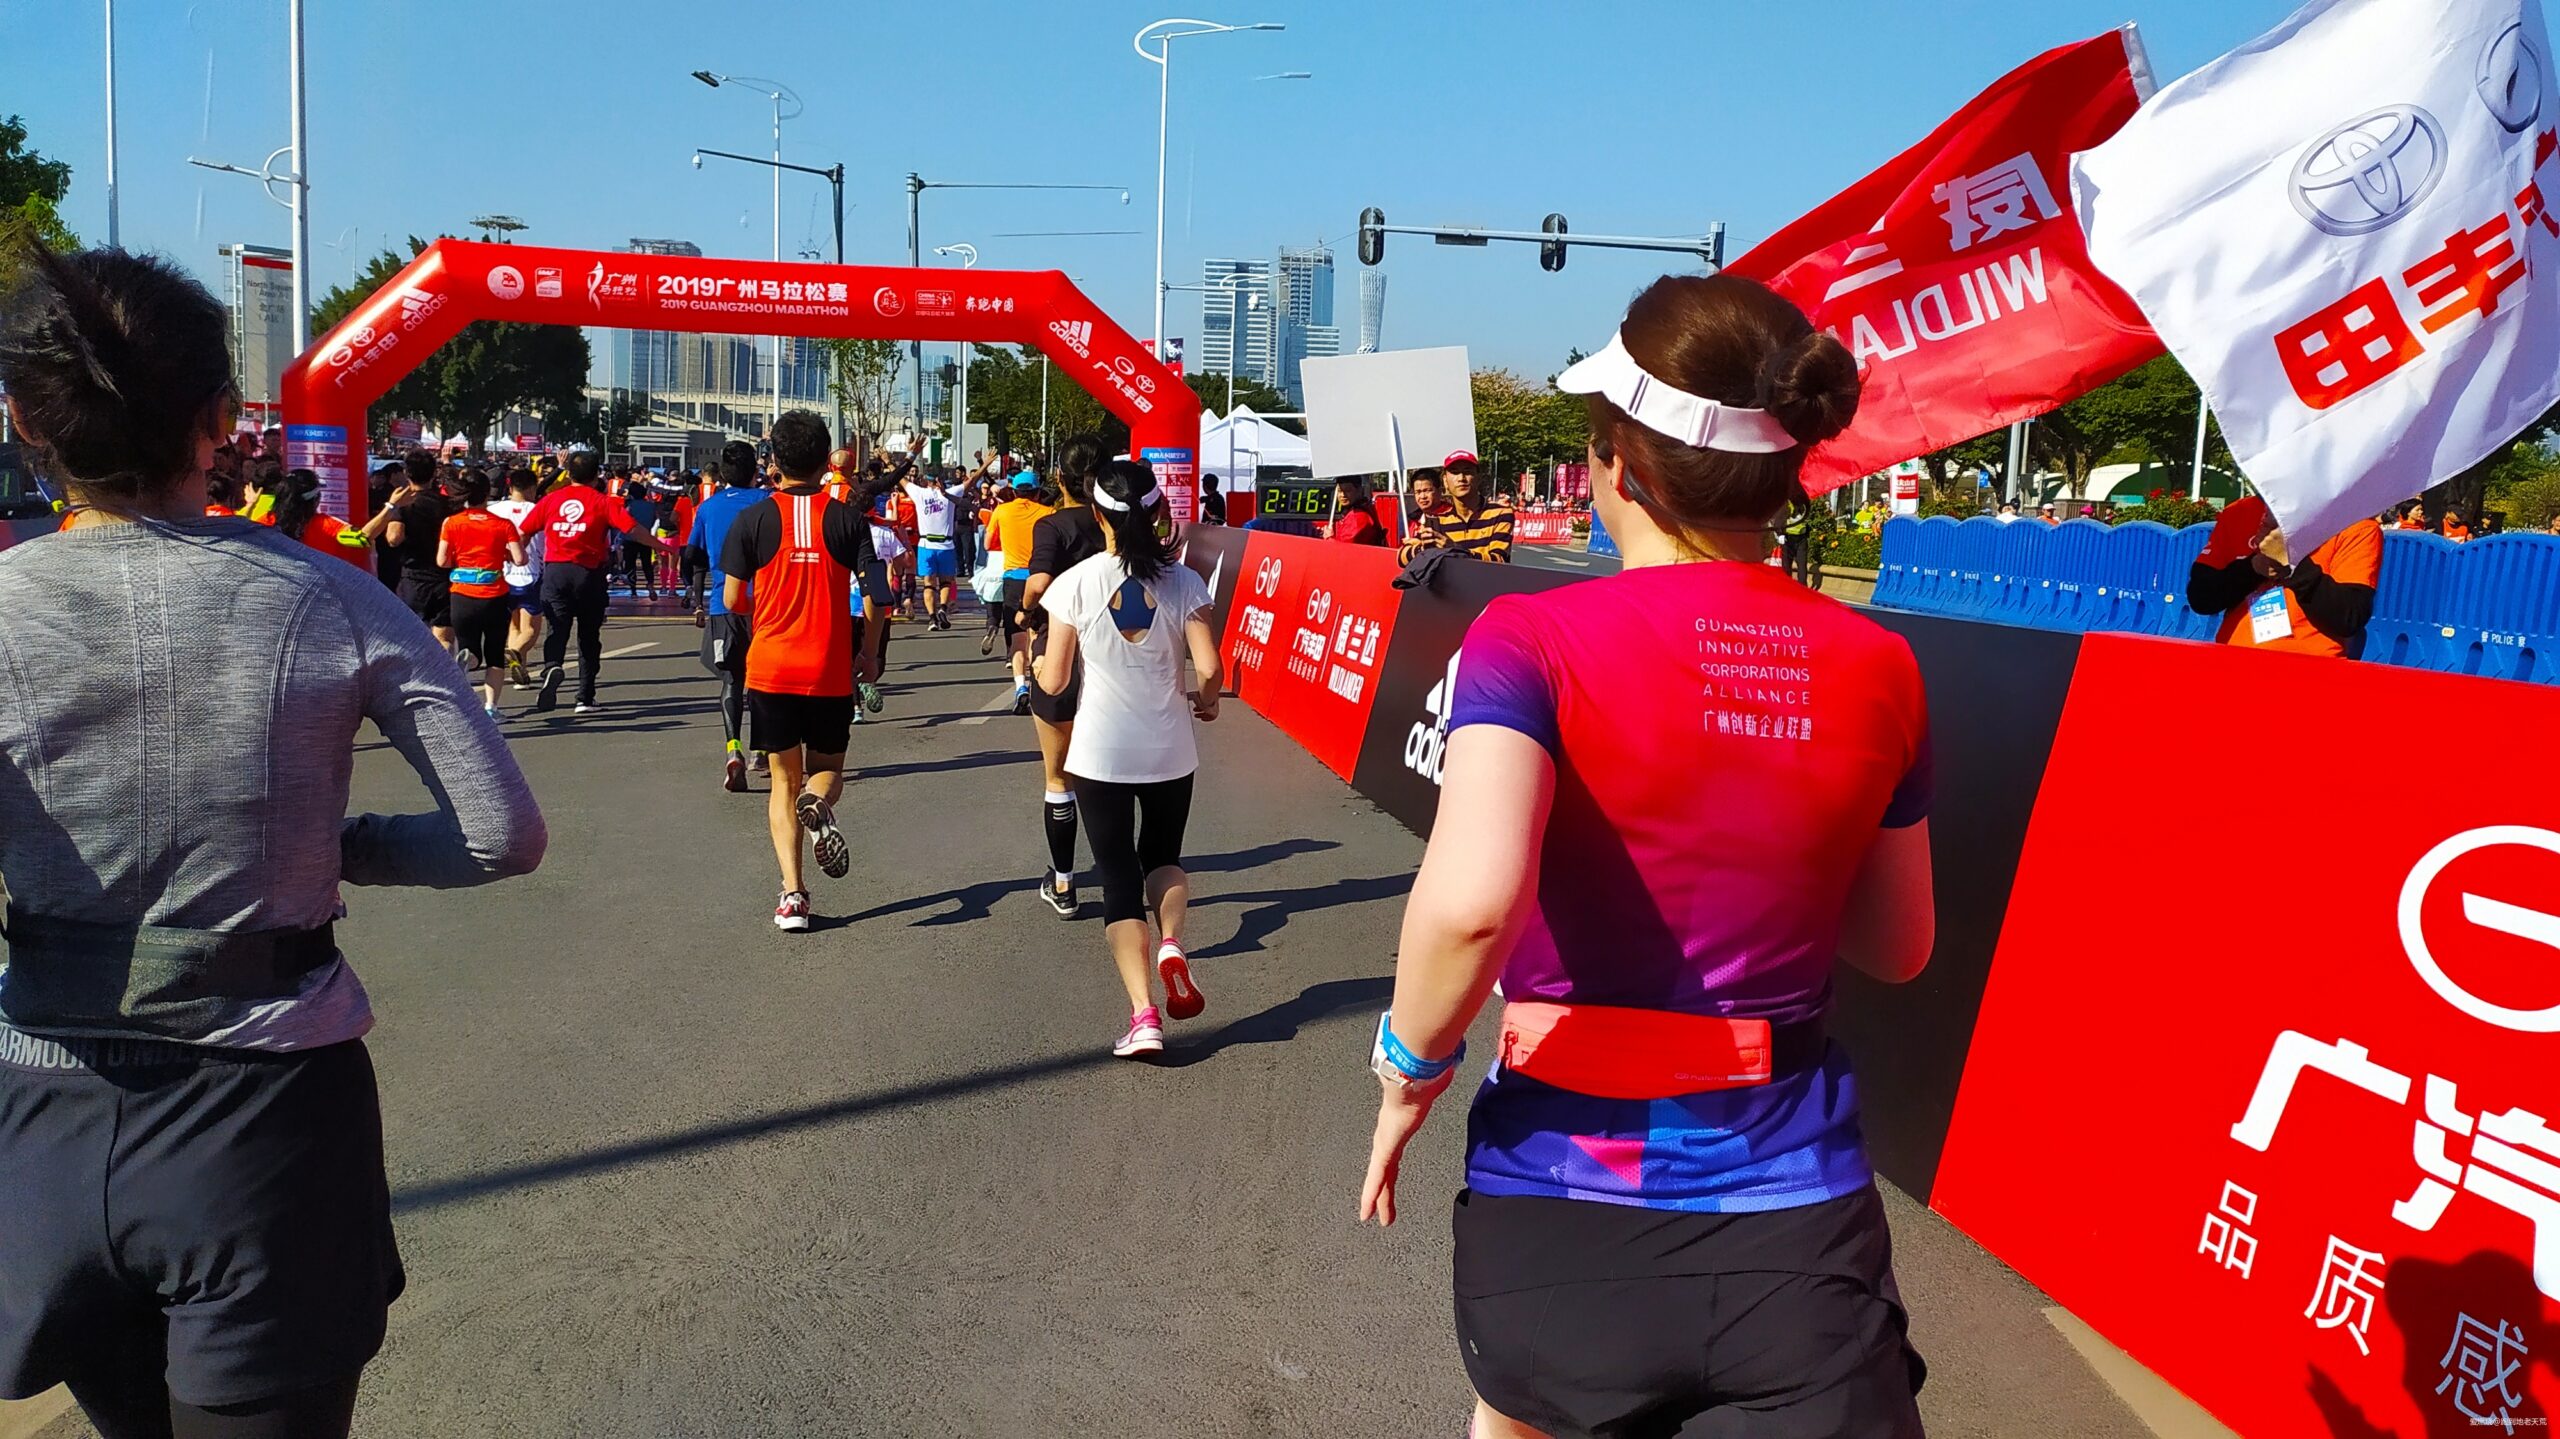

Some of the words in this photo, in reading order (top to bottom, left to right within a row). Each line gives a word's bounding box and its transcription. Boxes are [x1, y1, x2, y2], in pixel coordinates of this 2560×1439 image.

[657, 275, 848, 302] 2019广州马拉松赛
[403, 294, 448, 331] adidas
[661, 299, 687, 310] 2019
[690, 302, 773, 314] GUANGZHOU
[775, 304, 849, 316] MARATHON
[965, 296, 1014, 314] 奔跑中国
[1048, 321, 1090, 359] adidas
[1092, 361, 1154, 414] 广汽丰田
[1695, 617, 1804, 638] GUANGZHOU
[2491, 633, 2514, 646] POLICE
[1334, 613, 1381, 667] 威兰达
[1698, 640, 1810, 659] INNOVATIVE
[1700, 662, 1810, 681] CORPORATIONS
[1327, 664, 1365, 704] WILDLANDER
[1703, 683, 1811, 705] ALLIANCE
[1704, 710, 1812, 741] 广州创新企业联盟
